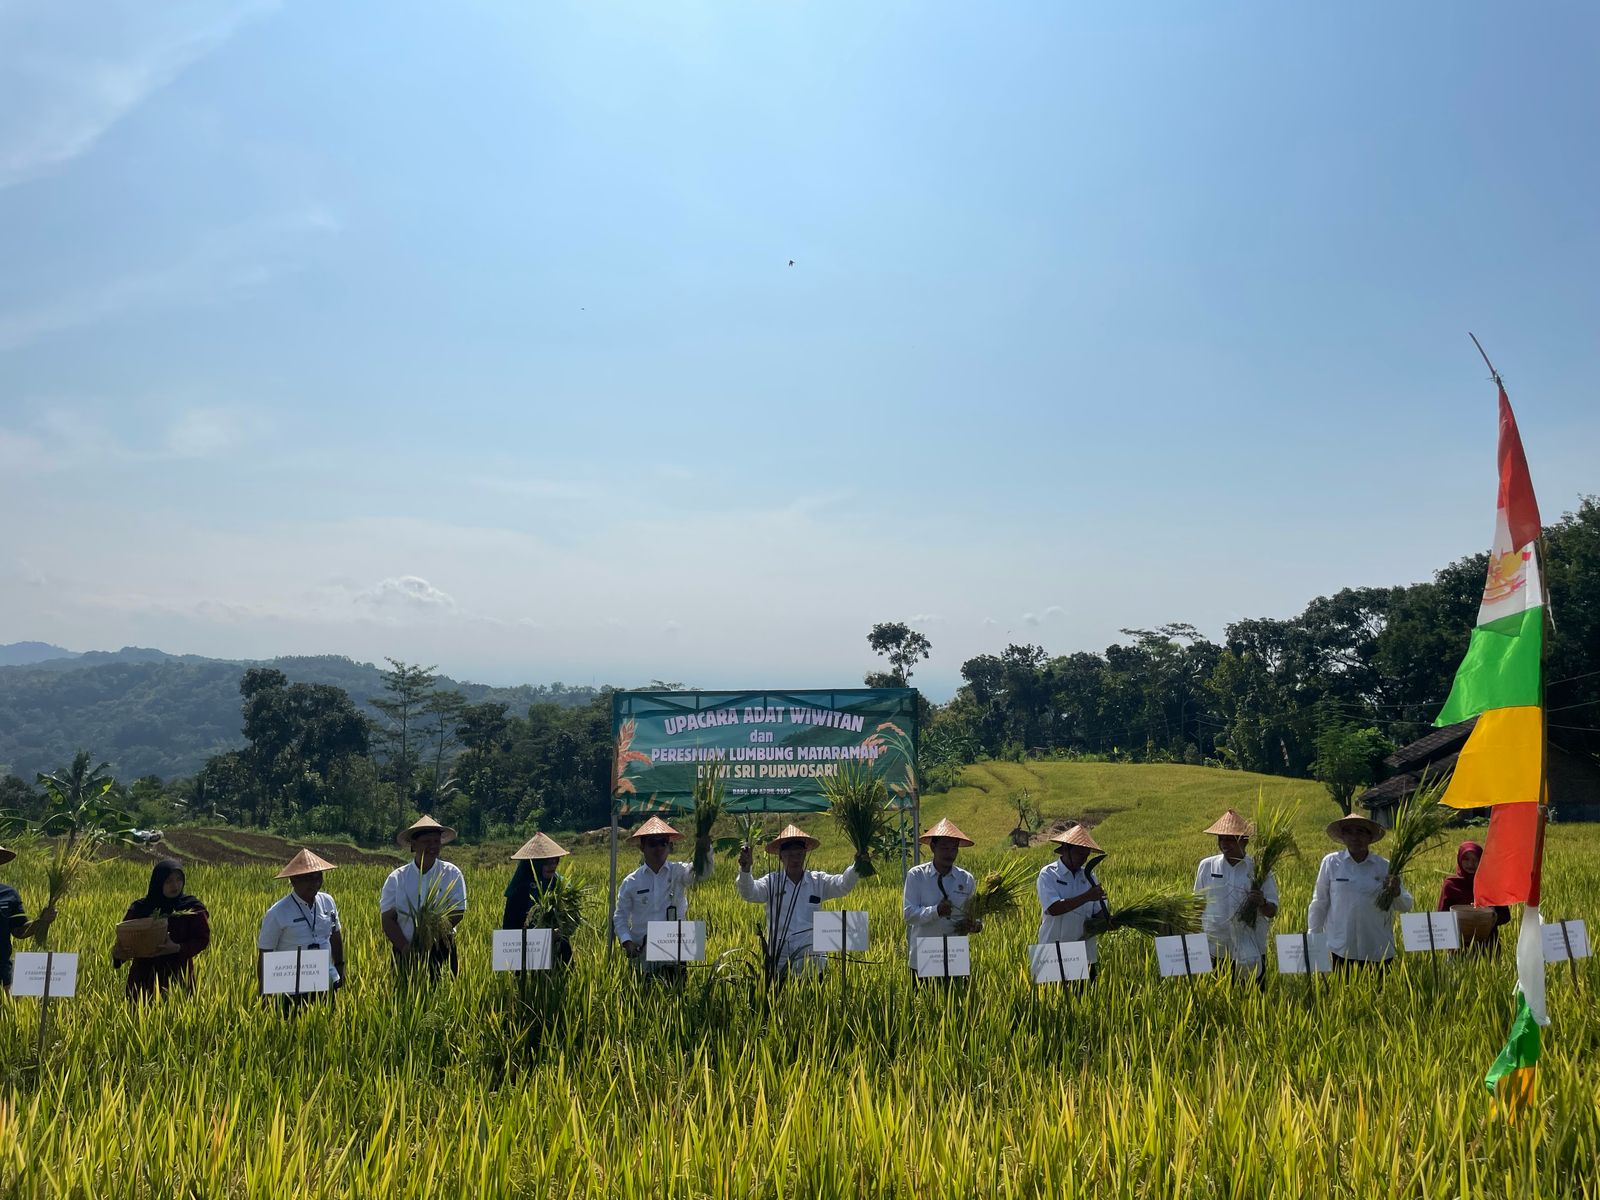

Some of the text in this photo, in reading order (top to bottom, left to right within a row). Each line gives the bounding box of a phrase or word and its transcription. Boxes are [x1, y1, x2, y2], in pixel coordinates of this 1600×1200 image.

[664, 706, 865, 735] UPACARA ADAT WIWITAN
[750, 729, 774, 743] dan
[651, 746, 879, 762] PERESMIAN LUMBUNG MATARAMAN
[734, 764, 755, 778] SRI
[759, 763, 838, 778] PURWOSARI
